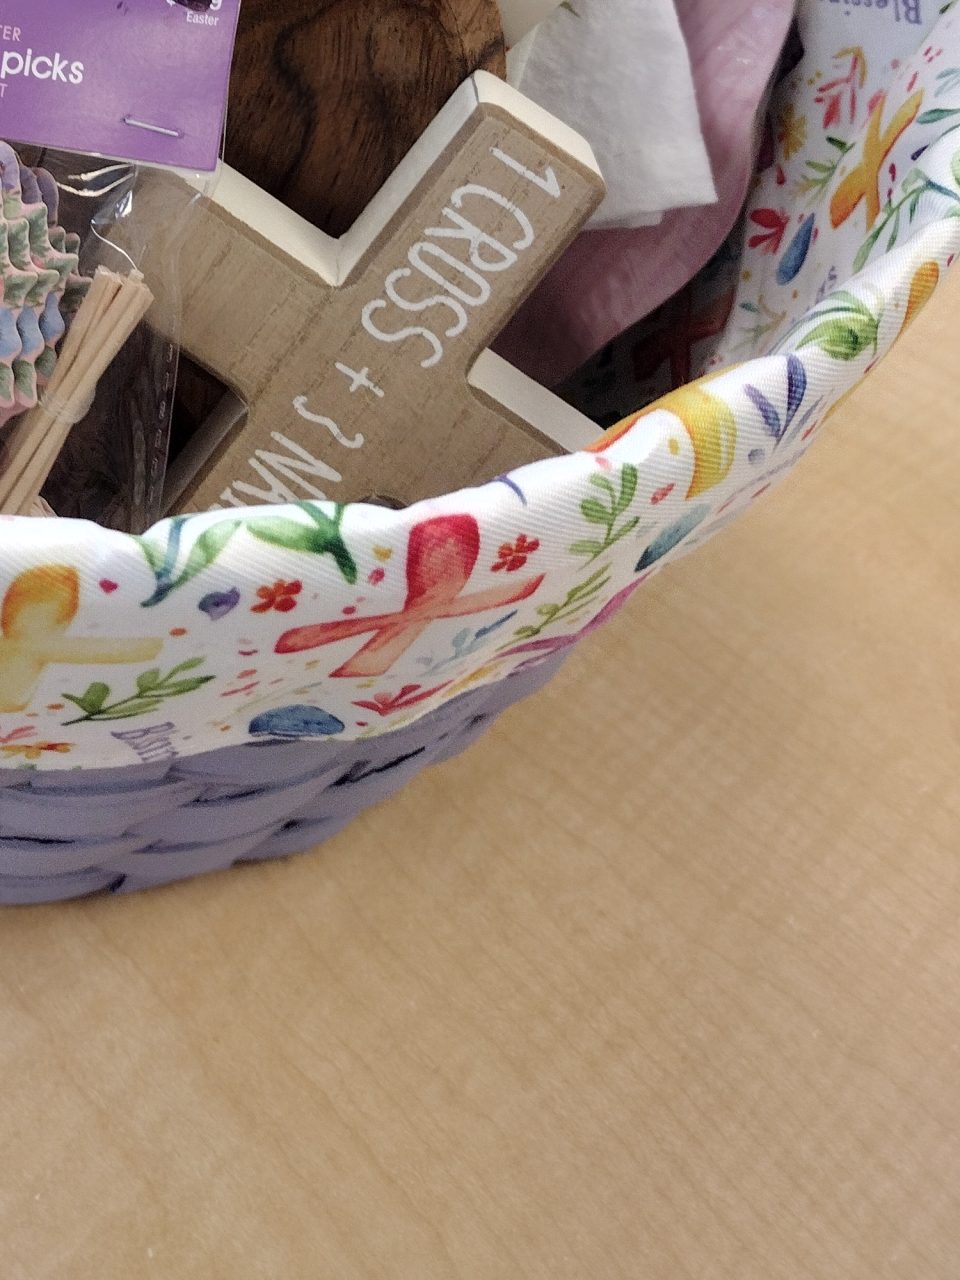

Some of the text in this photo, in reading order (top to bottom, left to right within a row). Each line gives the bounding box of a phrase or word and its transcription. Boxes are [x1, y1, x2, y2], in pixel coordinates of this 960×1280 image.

[186, 11, 219, 26] Easter
[0, 48, 84, 84] picks
[490, 146, 561, 199] 1
[361, 183, 535, 369] CROSS
